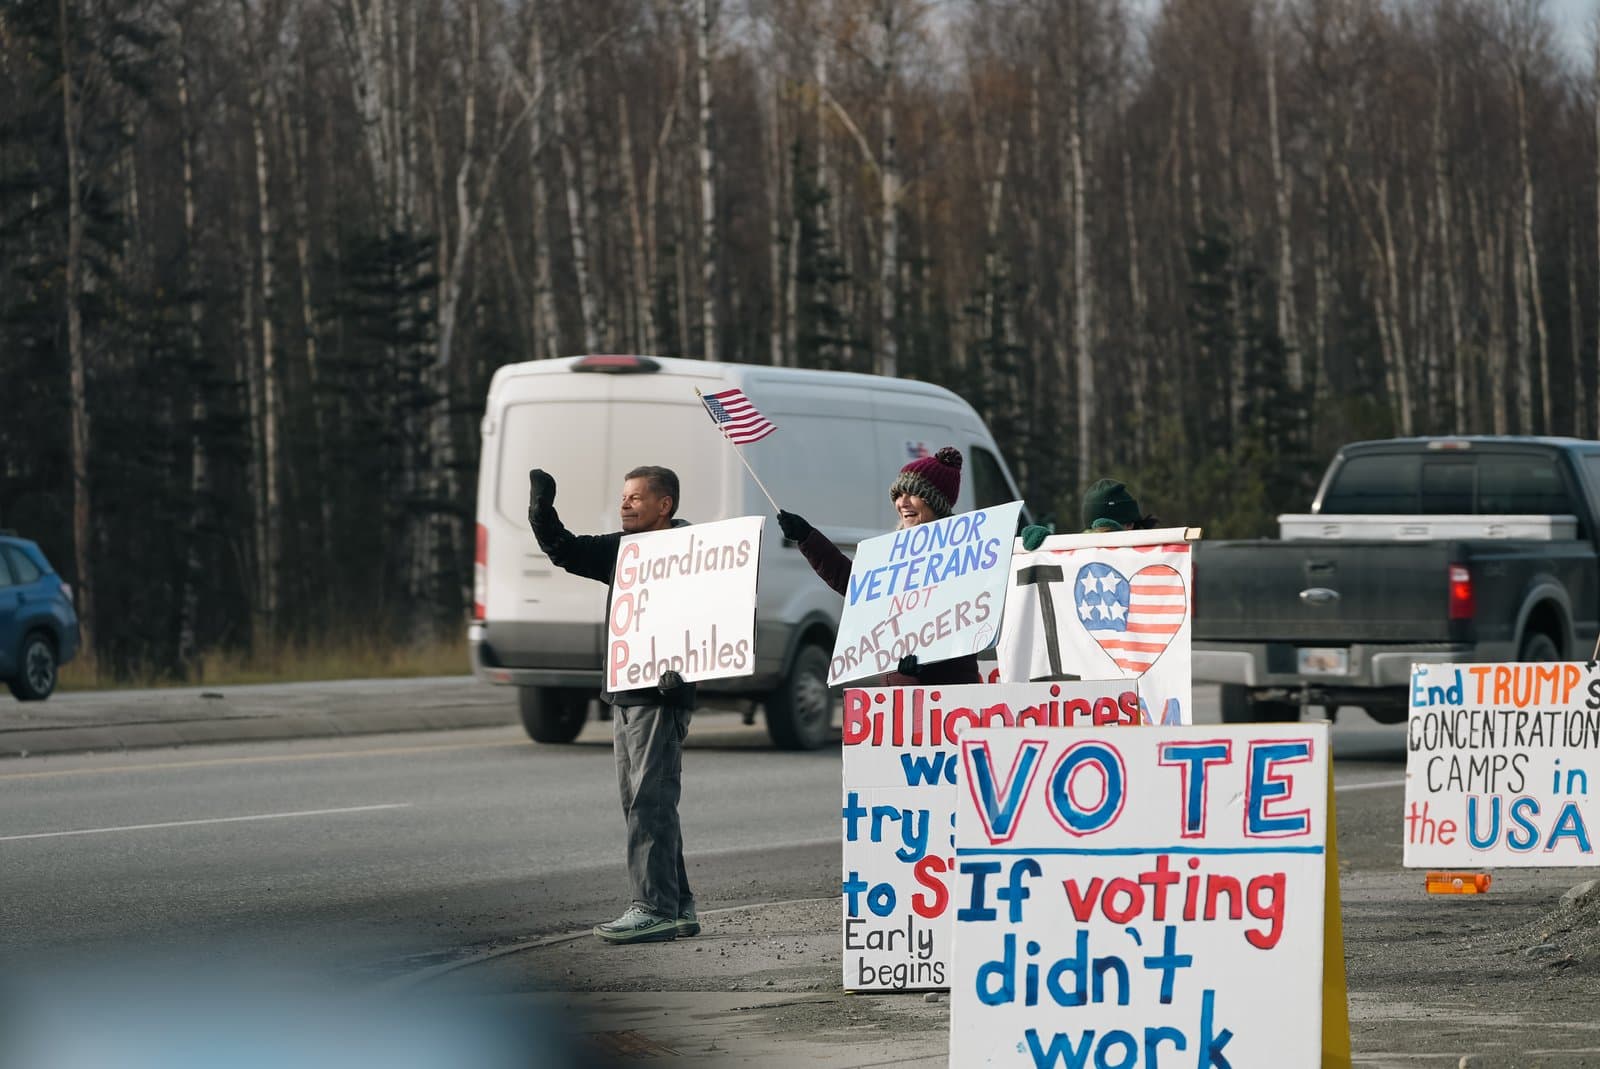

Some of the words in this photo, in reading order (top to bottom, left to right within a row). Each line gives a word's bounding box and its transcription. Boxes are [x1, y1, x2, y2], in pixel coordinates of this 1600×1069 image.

[616, 534, 751, 590] Guardians
[889, 511, 987, 562] HONOR
[850, 537, 1001, 606] VETERANS
[610, 588, 649, 637] Of
[888, 585, 939, 617] NOT
[830, 613, 905, 681] DRAFT
[874, 590, 991, 672] DODGERS
[1412, 668, 1464, 707] End
[1409, 709, 1600, 752] CONCENTRATION
[962, 738, 1314, 845] VOTE
[1427, 753, 1530, 793] CAMPS
[1553, 758, 1588, 795] in
[842, 791, 930, 863] try
[1406, 801, 1458, 846] the
[1466, 794, 1594, 854] USA
[842, 871, 897, 917] to
[957, 858, 1043, 923] If
[1062, 854, 1287, 950] voting
[846, 914, 934, 960] Early
[858, 955, 946, 991] begins
[975, 925, 1193, 1007] didn't
[1025, 989, 1234, 1069] work
